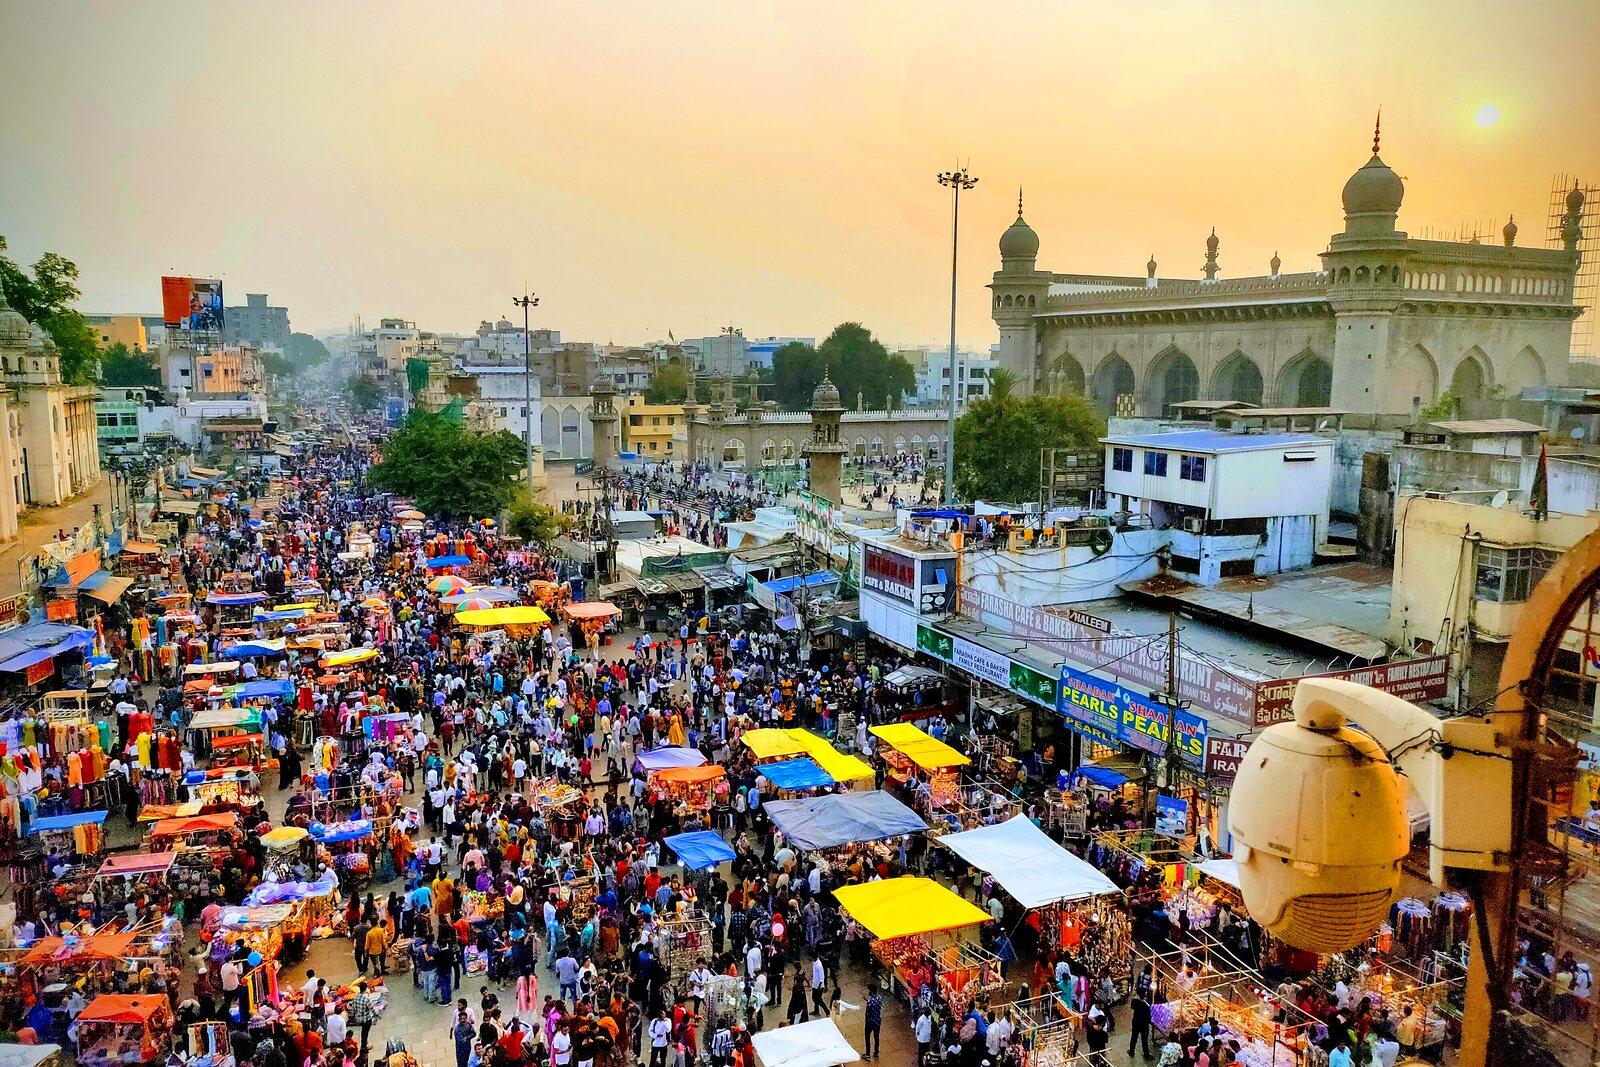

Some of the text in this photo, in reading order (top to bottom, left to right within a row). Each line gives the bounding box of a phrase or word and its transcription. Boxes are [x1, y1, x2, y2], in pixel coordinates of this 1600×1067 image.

[884, 580, 915, 604] BAKERY
[1075, 613, 1108, 631] HALEEM
[981, 592, 1014, 620] FARASHA
[1015, 605, 1035, 627] CAFE
[1035, 614, 1041, 630] &
[1043, 614, 1078, 641] BAKERY
[1101, 633, 1138, 662] FAMILY
[1139, 645, 1213, 689] RESTRANT
[990, 662, 1008, 674] BAKERY
[1062, 685, 1119, 719] PEARLS
[1128, 701, 1197, 737] SHAAAN
[1210, 740, 1248, 758] FAR
[1213, 760, 1237, 772] IRA
